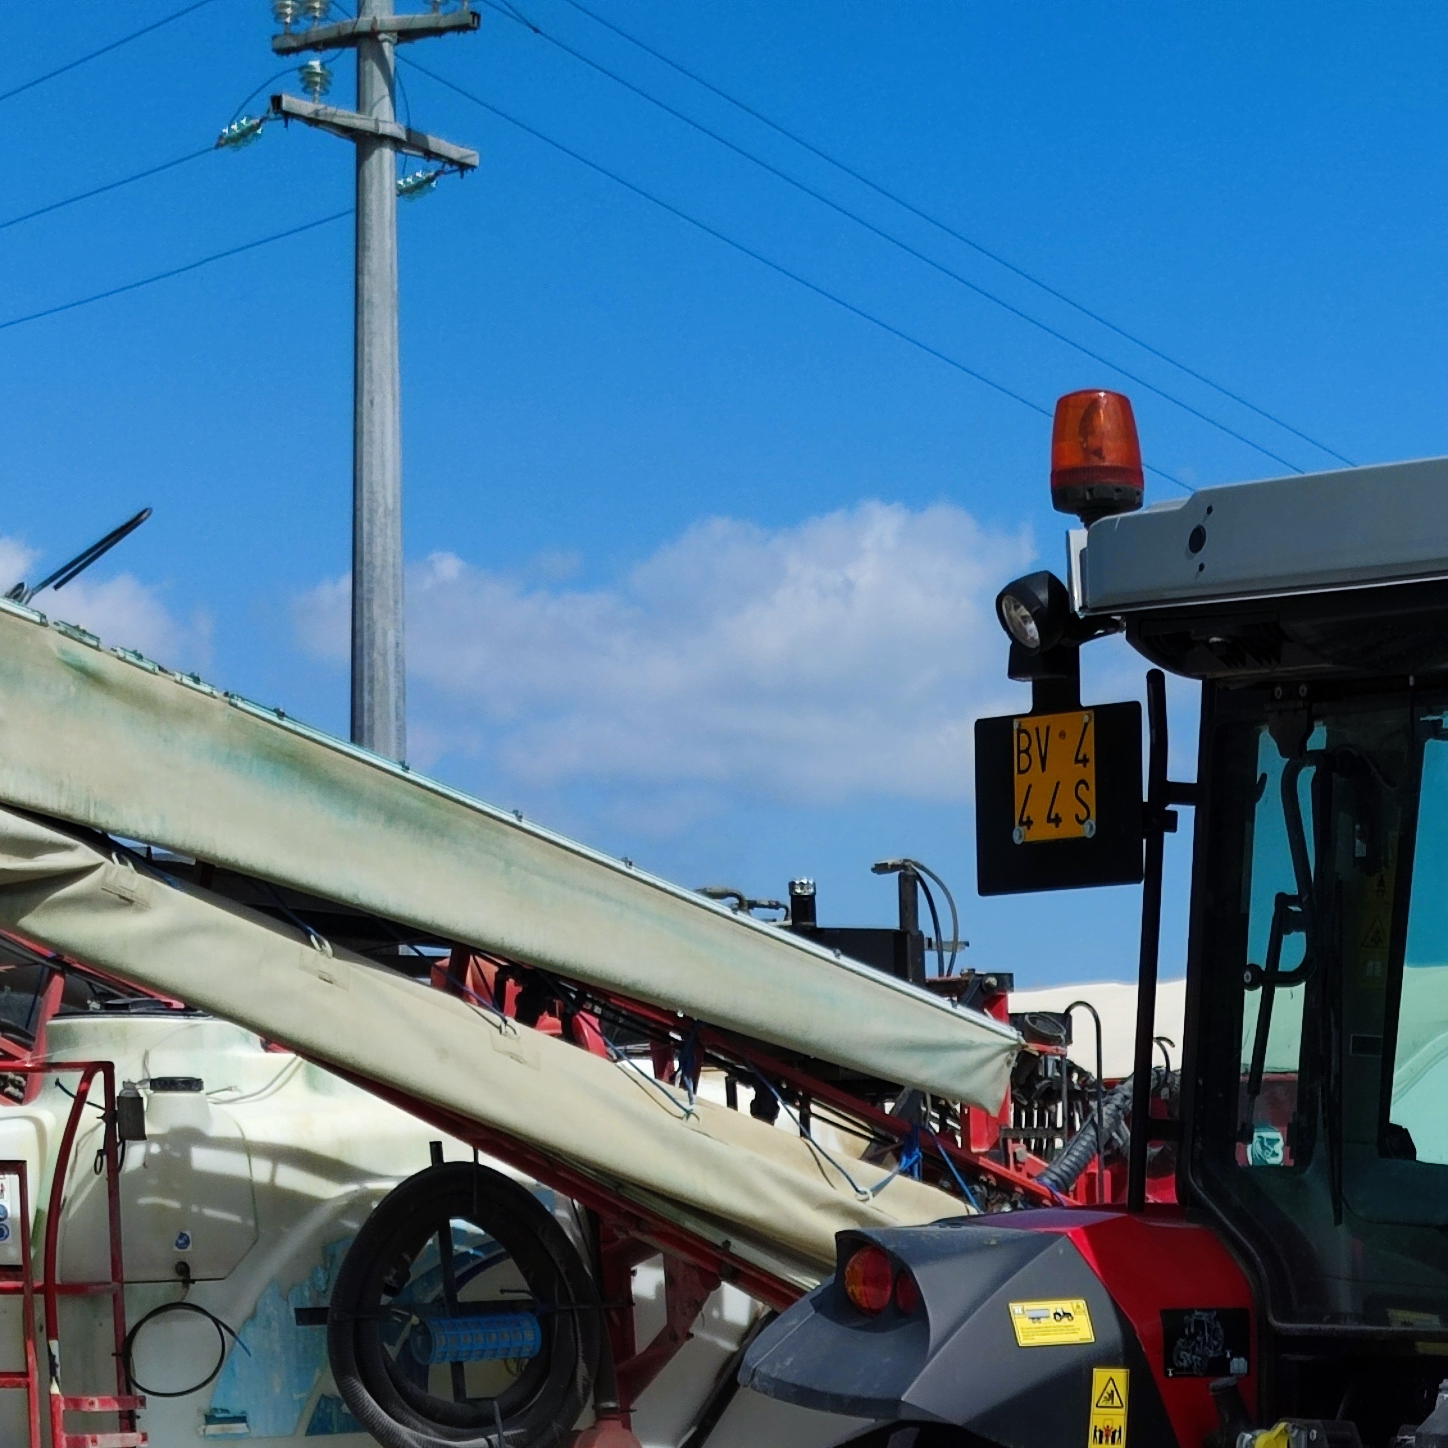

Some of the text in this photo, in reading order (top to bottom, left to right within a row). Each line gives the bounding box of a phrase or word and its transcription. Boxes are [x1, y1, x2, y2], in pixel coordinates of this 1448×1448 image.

[1017, 721, 1090, 775] BV 4
[1018, 778, 1091, 831] 44S
